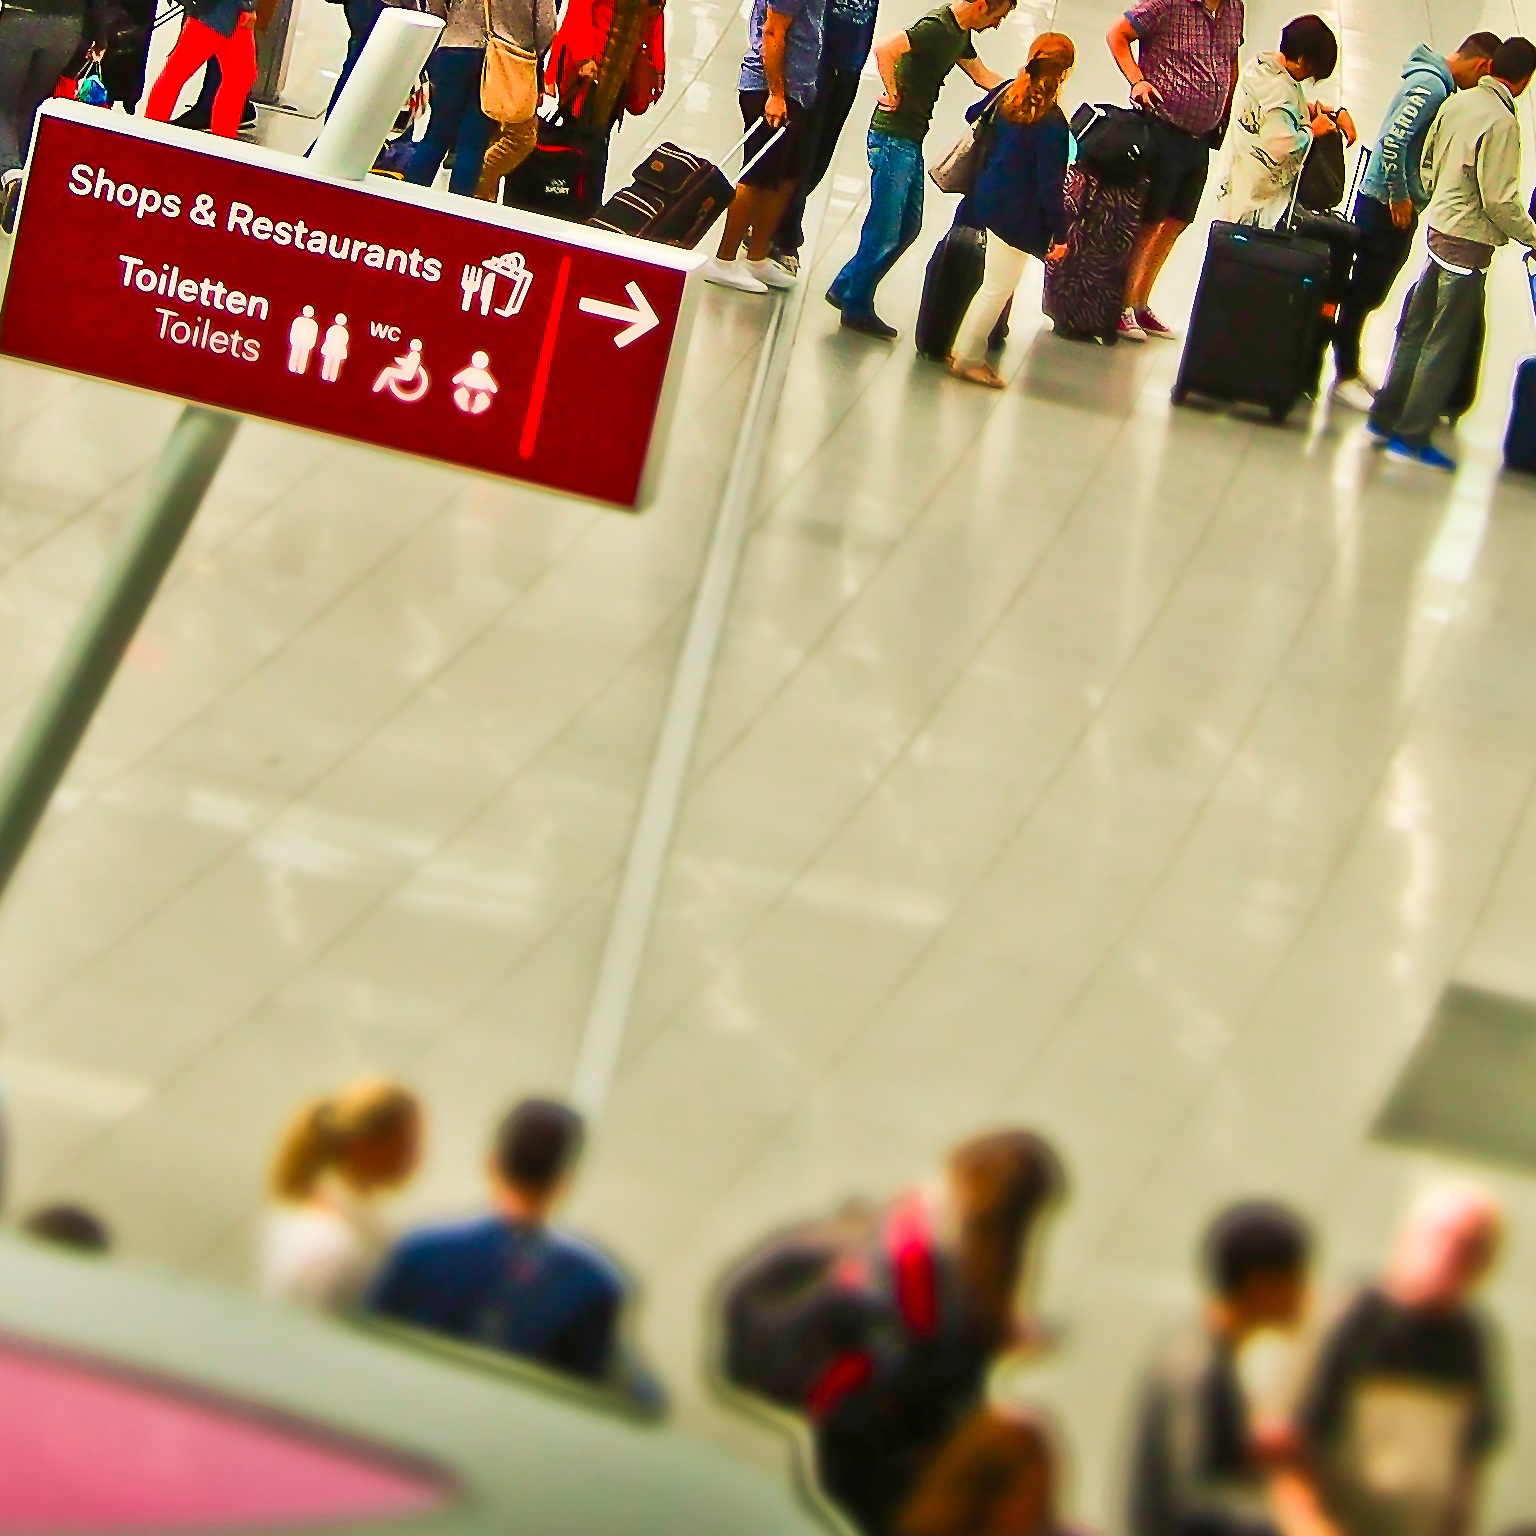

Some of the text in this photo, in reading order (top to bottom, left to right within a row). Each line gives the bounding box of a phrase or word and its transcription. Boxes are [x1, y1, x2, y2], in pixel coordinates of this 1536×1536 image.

[67, 163, 444, 283] Shops & Restaurants
[118, 253, 270, 321] Toiletten
[154, 306, 262, 363] Toilets
[368, 319, 403, 343] WC
